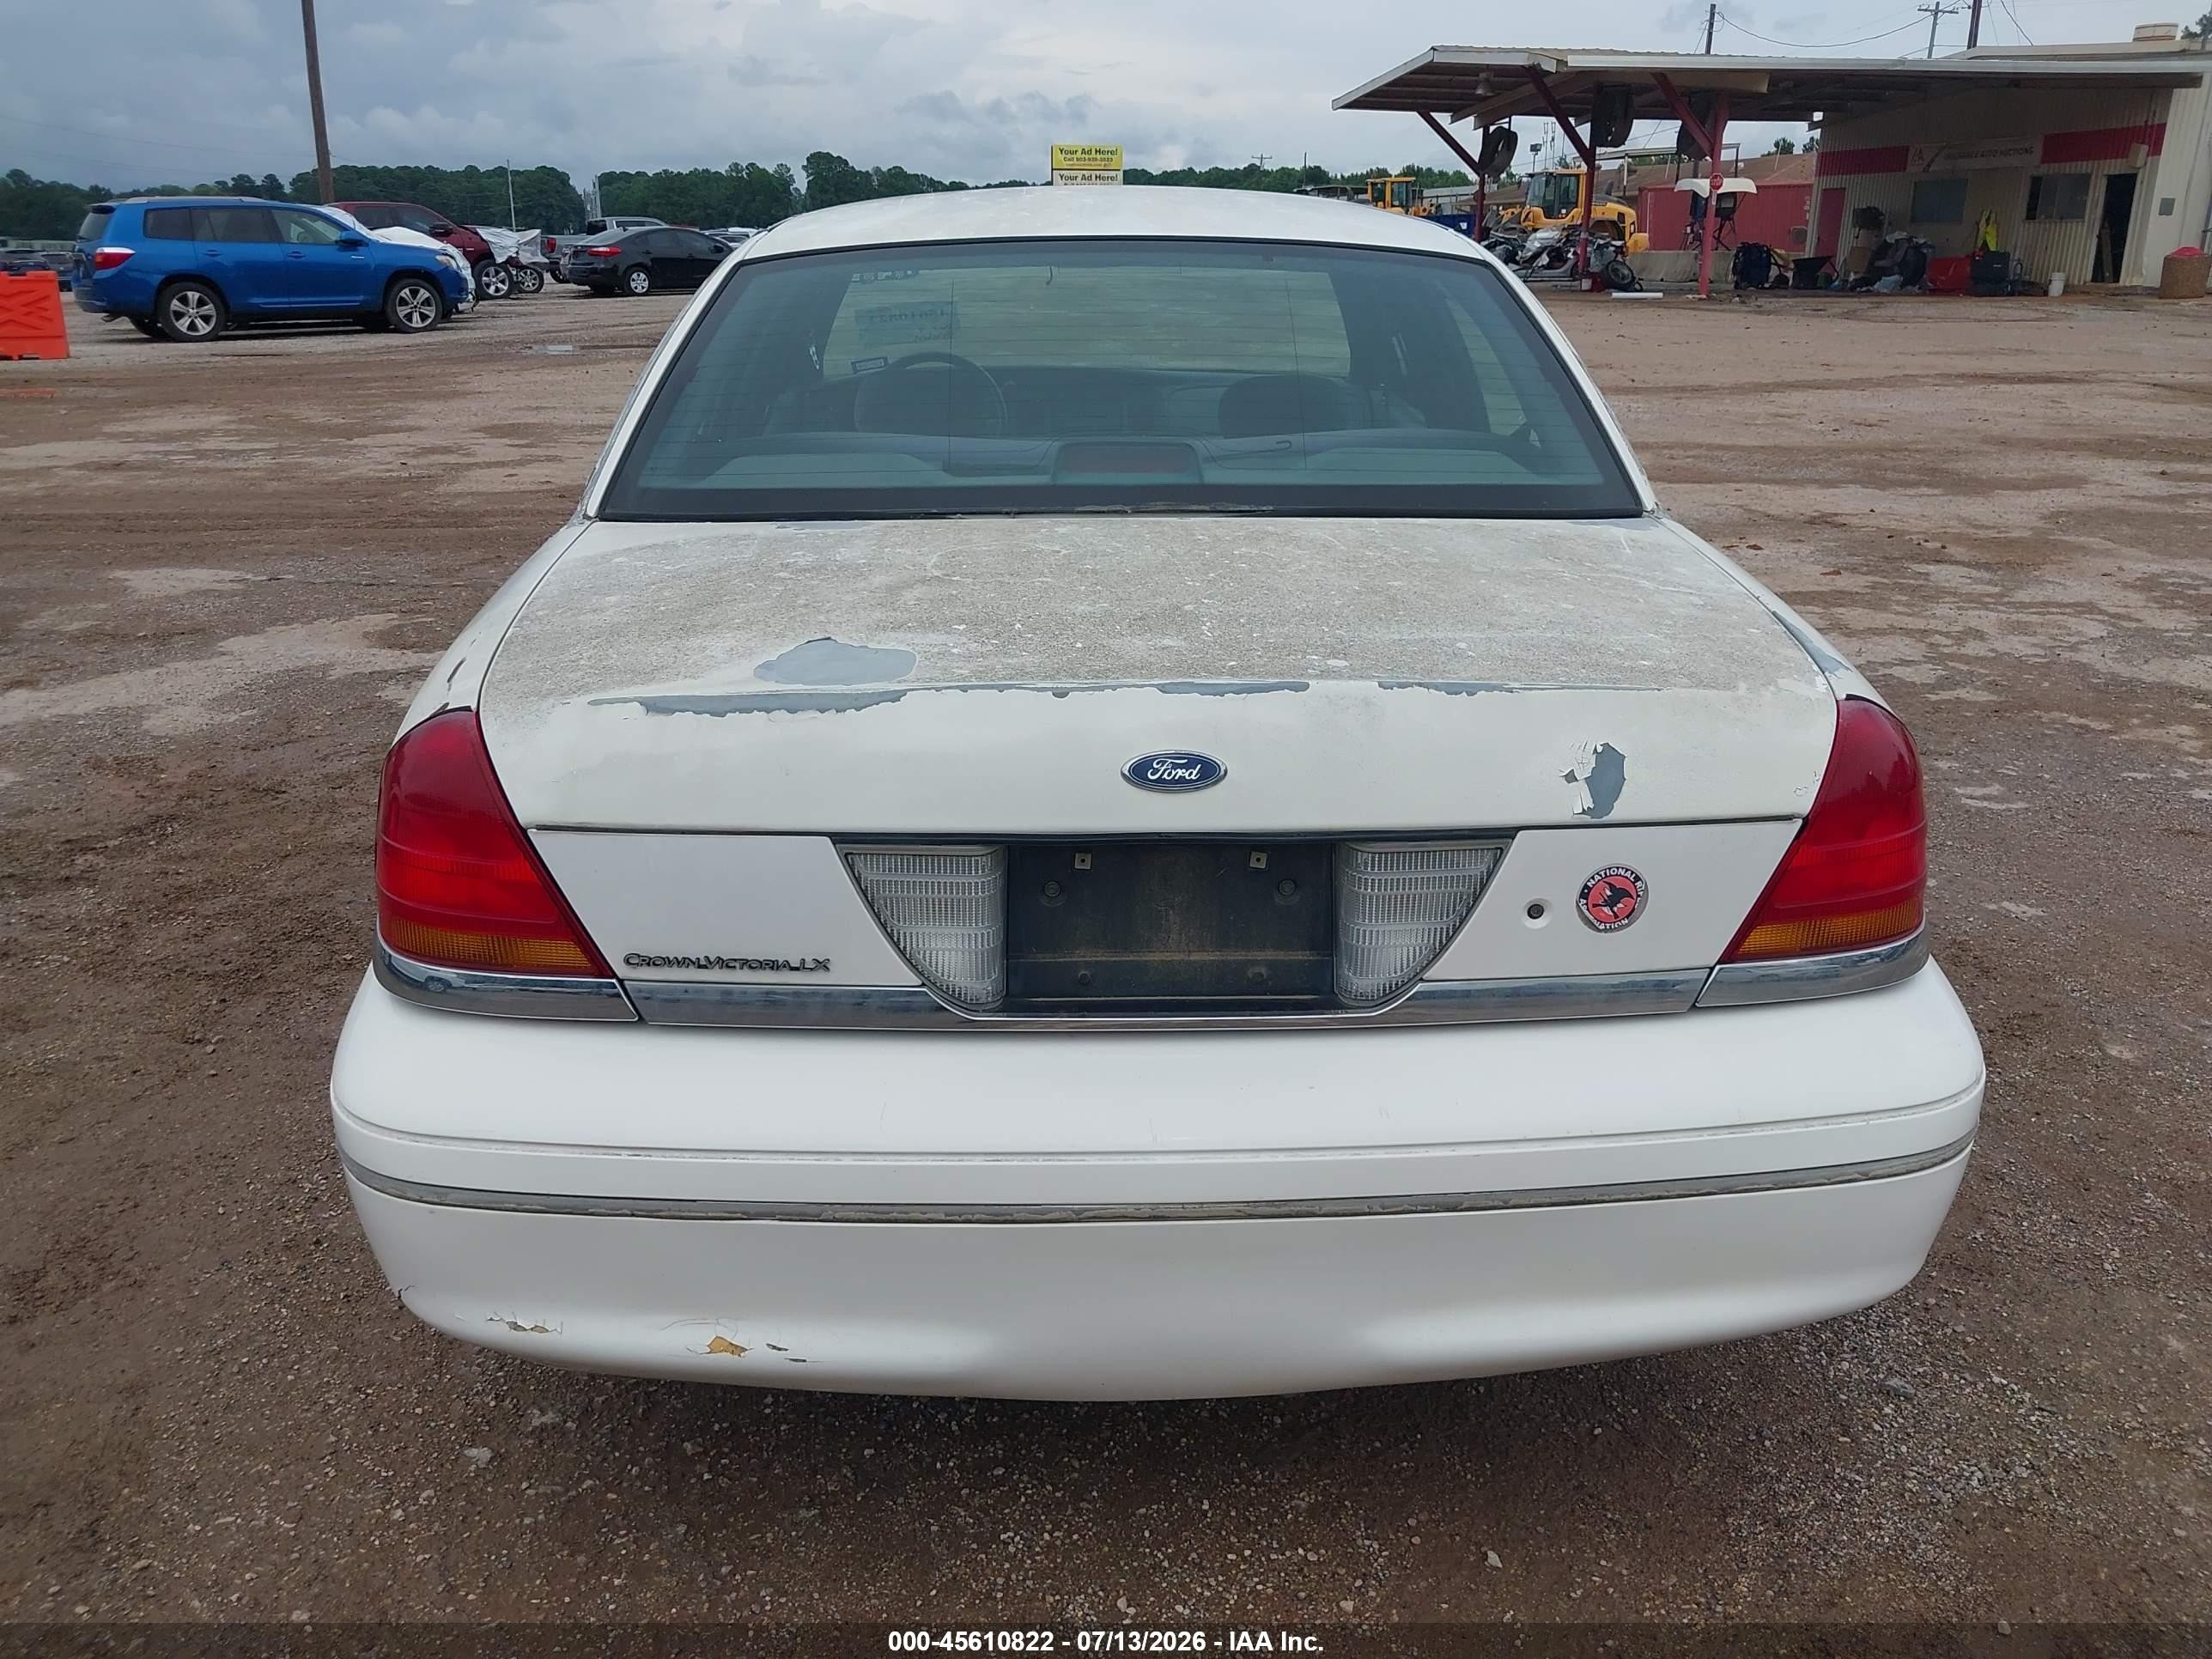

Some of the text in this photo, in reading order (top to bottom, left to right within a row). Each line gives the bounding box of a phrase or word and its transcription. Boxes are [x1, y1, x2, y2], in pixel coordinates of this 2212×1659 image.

[1081, 173, 1092, 182] Ad
[1095, 173, 1118, 182] Here!
[1147, 758, 1201, 780] Ford
[1586, 867, 1636, 888] NATIONAL
[623, 952, 830, 972] CROWN VICTORIA LX
